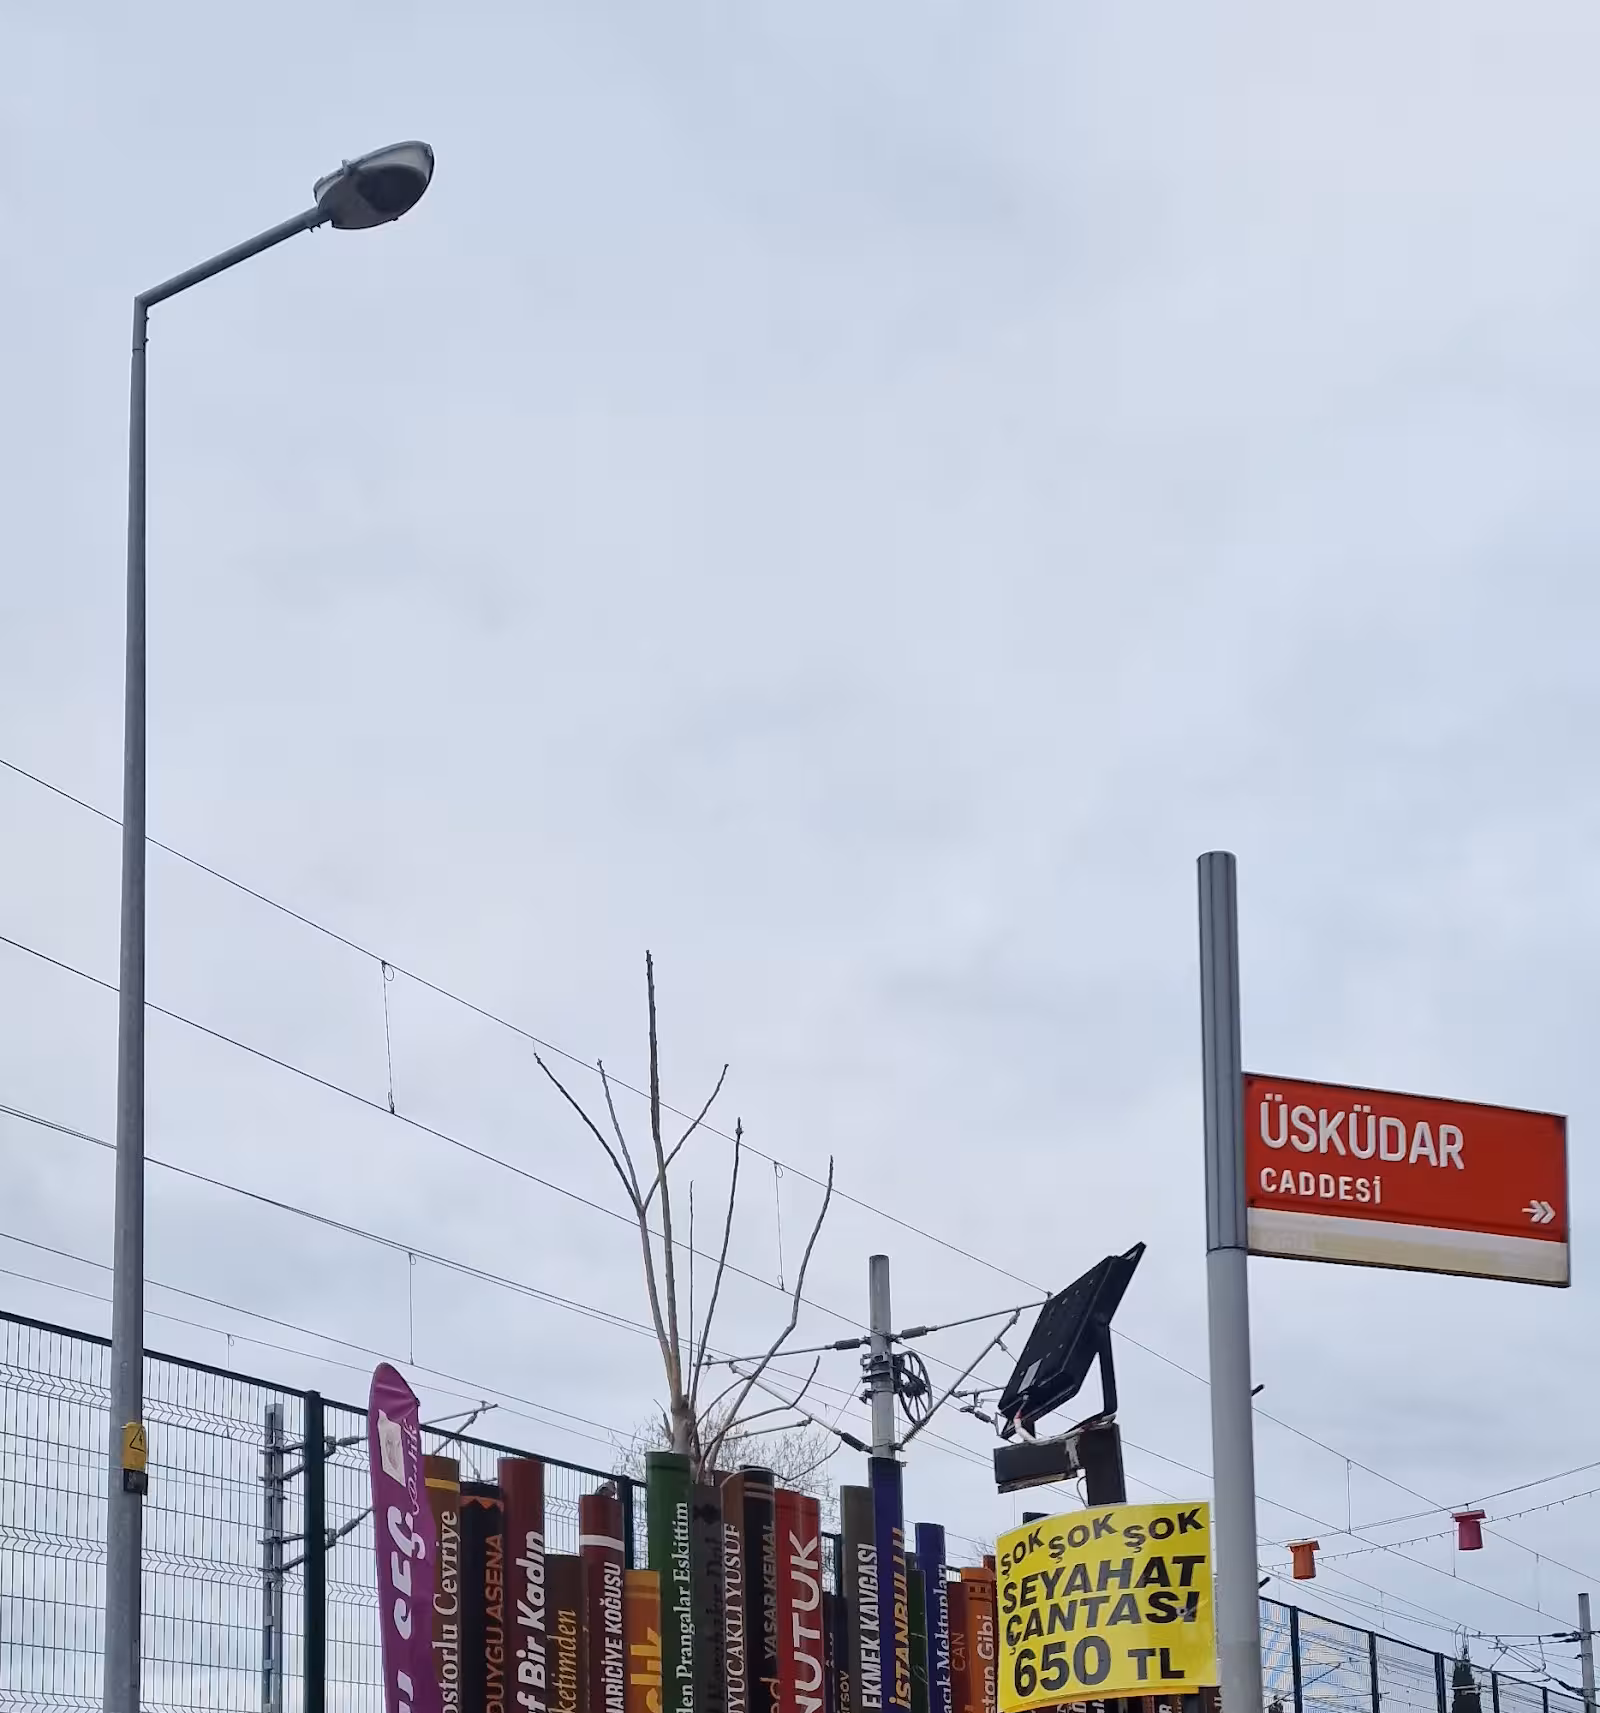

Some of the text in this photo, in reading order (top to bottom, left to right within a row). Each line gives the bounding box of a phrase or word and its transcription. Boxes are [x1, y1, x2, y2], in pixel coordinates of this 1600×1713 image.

[1260, 1092, 1465, 1171] ÜSKÜDAR
[1260, 1166, 1382, 1205] CADDESİ
[433, 1510, 461, 1616] Cevriye
[484, 1533, 504, 1623] ASENA
[670, 1501, 692, 1583] Eskittim
[722, 1523, 743, 1600] YUSUF
[1000, 1507, 1205, 1579] ŞOK ŞOK ŞOK
[515, 1530, 546, 1631] Kadın
[599, 1561, 624, 1635] KOĞUŞU
[1002, 1555, 1207, 1614] SEYAHAT
[674, 1585, 696, 1679] Prangalar
[857, 1543, 883, 1709] EKMEK KAVGASI
[951, 1631, 966, 1672] CAN
[975, 1614, 995, 1661] Gibi
[1006, 1591, 1200, 1656] ÇANTASI
[516, 1636, 546, 1689] Bir
[1014, 1635, 1186, 1698] 650 TL
